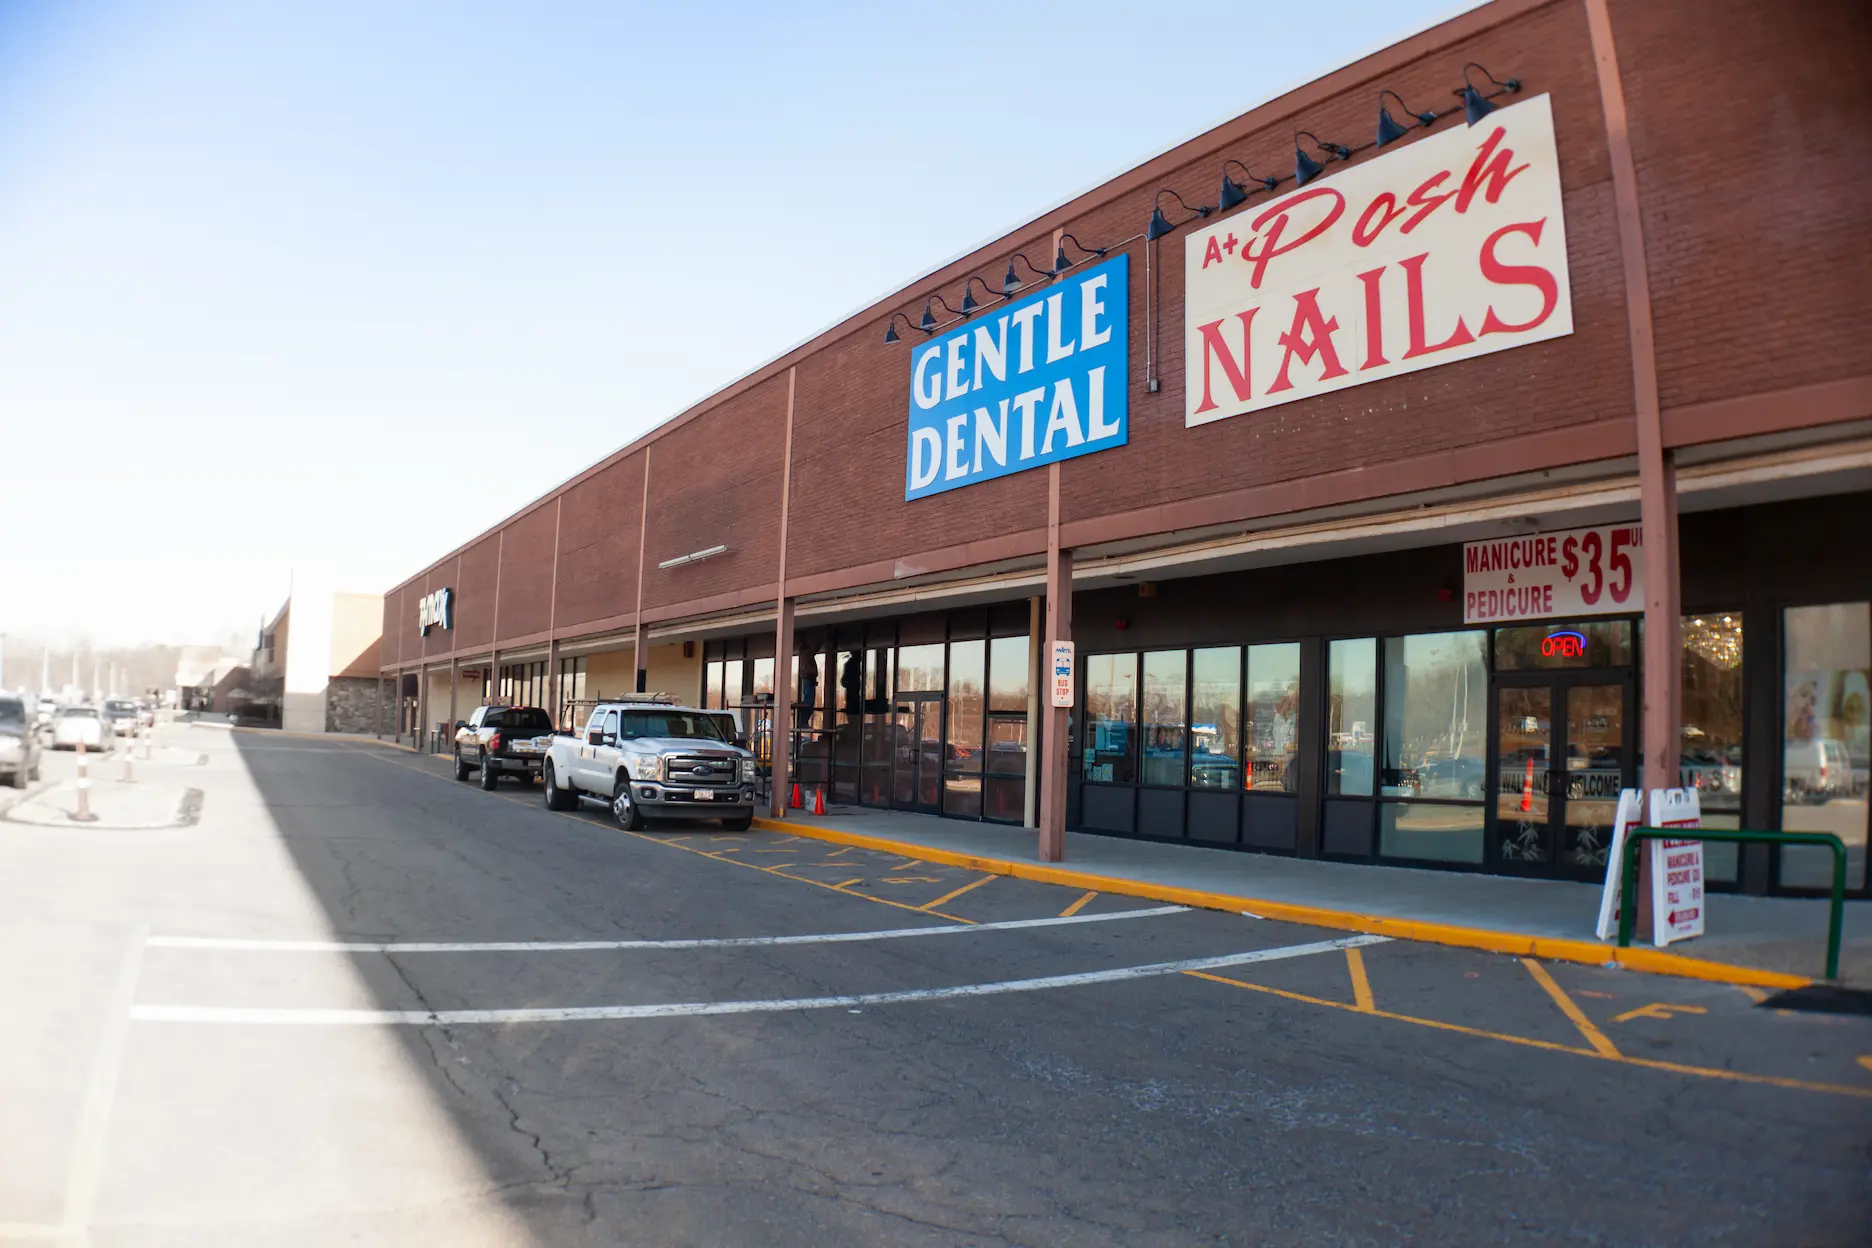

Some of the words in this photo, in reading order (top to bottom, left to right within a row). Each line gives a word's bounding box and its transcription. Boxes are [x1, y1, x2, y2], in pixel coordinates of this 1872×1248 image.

[1202, 232, 1238, 269] A+
[1241, 126, 1531, 289] Posh
[913, 273, 1112, 409] GENTLE
[1193, 216, 1558, 414] NAILS
[910, 365, 1120, 491] DENTAL
[1467, 537, 1557, 573] MANICURE
[1561, 527, 1632, 606] $35
[1508, 572, 1515, 584] &
[1467, 584, 1553, 619] PEDICURE
[1541, 636, 1584, 657] OPEN
[1056, 688, 1069, 696] STOP
[1057, 679, 1068, 687] BUS
